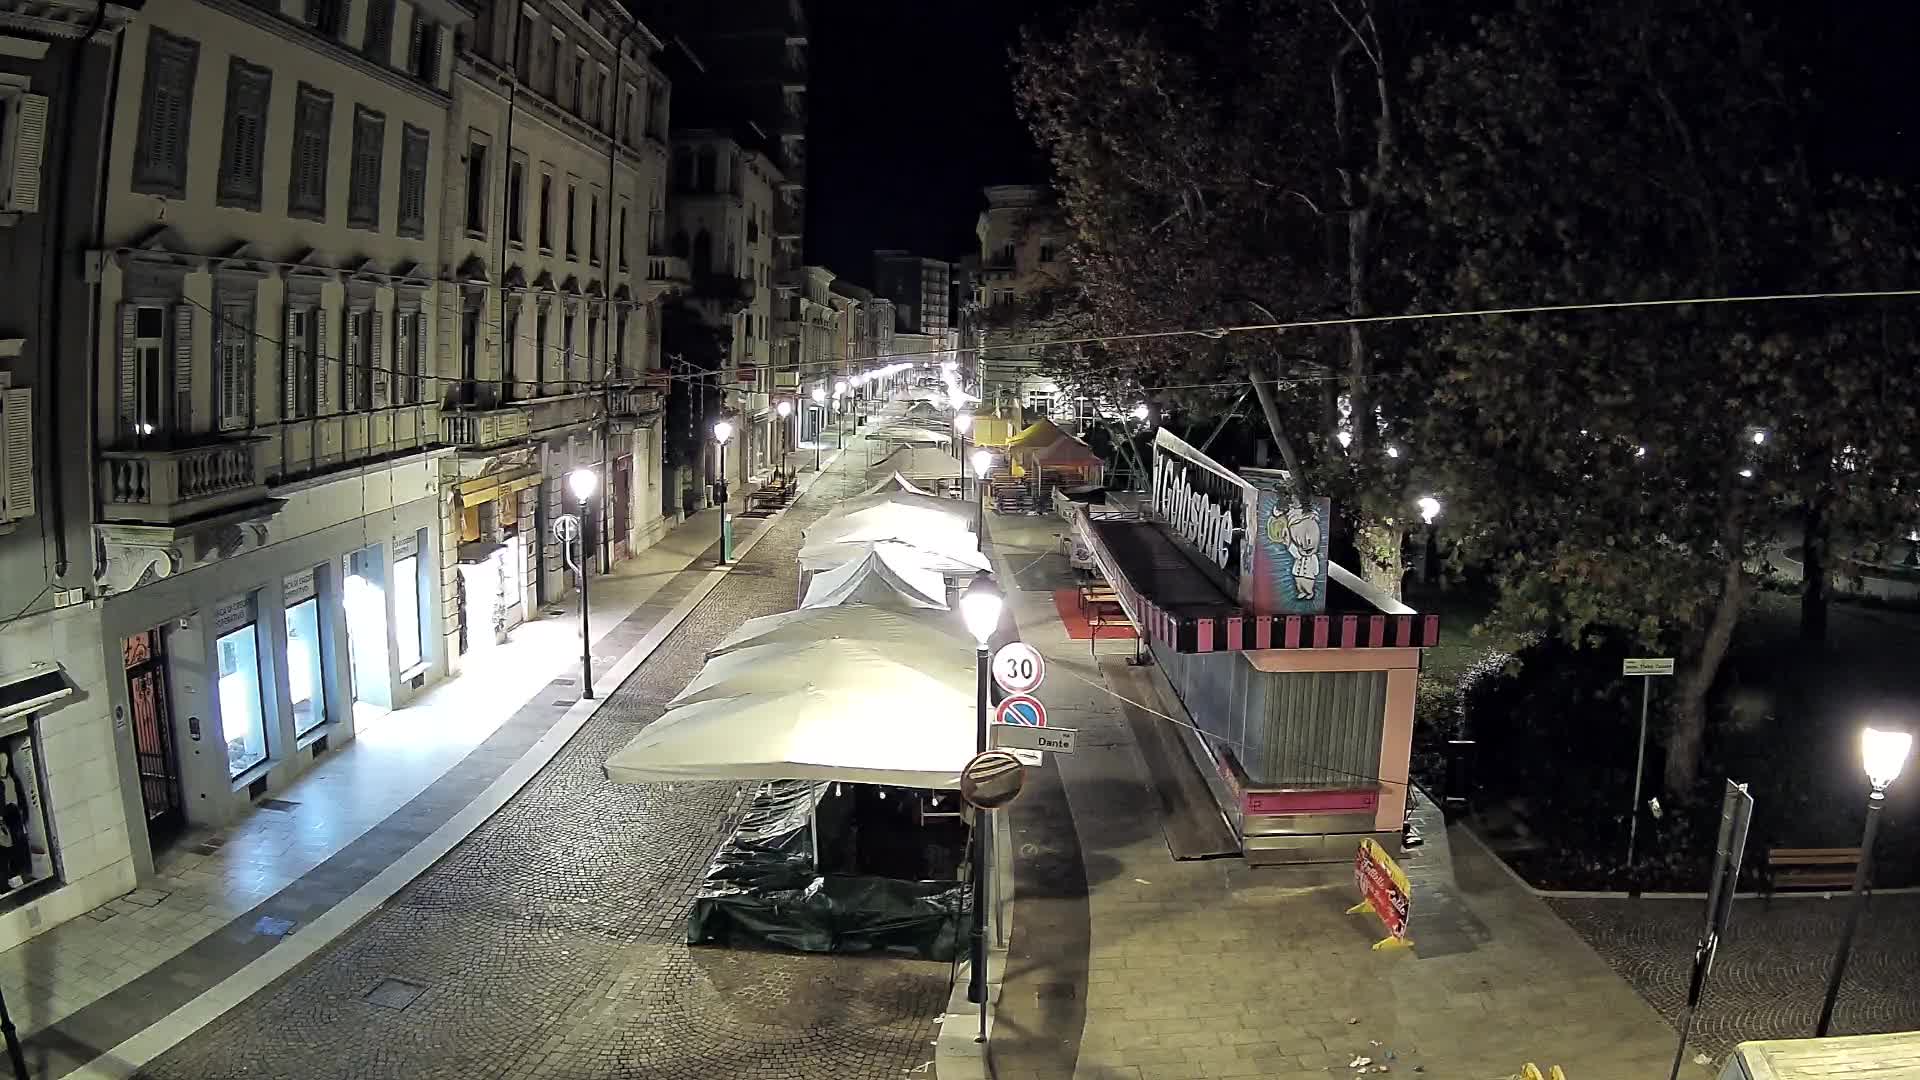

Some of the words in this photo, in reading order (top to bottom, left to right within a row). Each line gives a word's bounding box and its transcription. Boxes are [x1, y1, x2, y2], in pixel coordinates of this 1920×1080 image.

[1162, 457, 1233, 570] Golosone
[1007, 658, 1033, 680] 30
[1038, 737, 1070, 749] Dante
